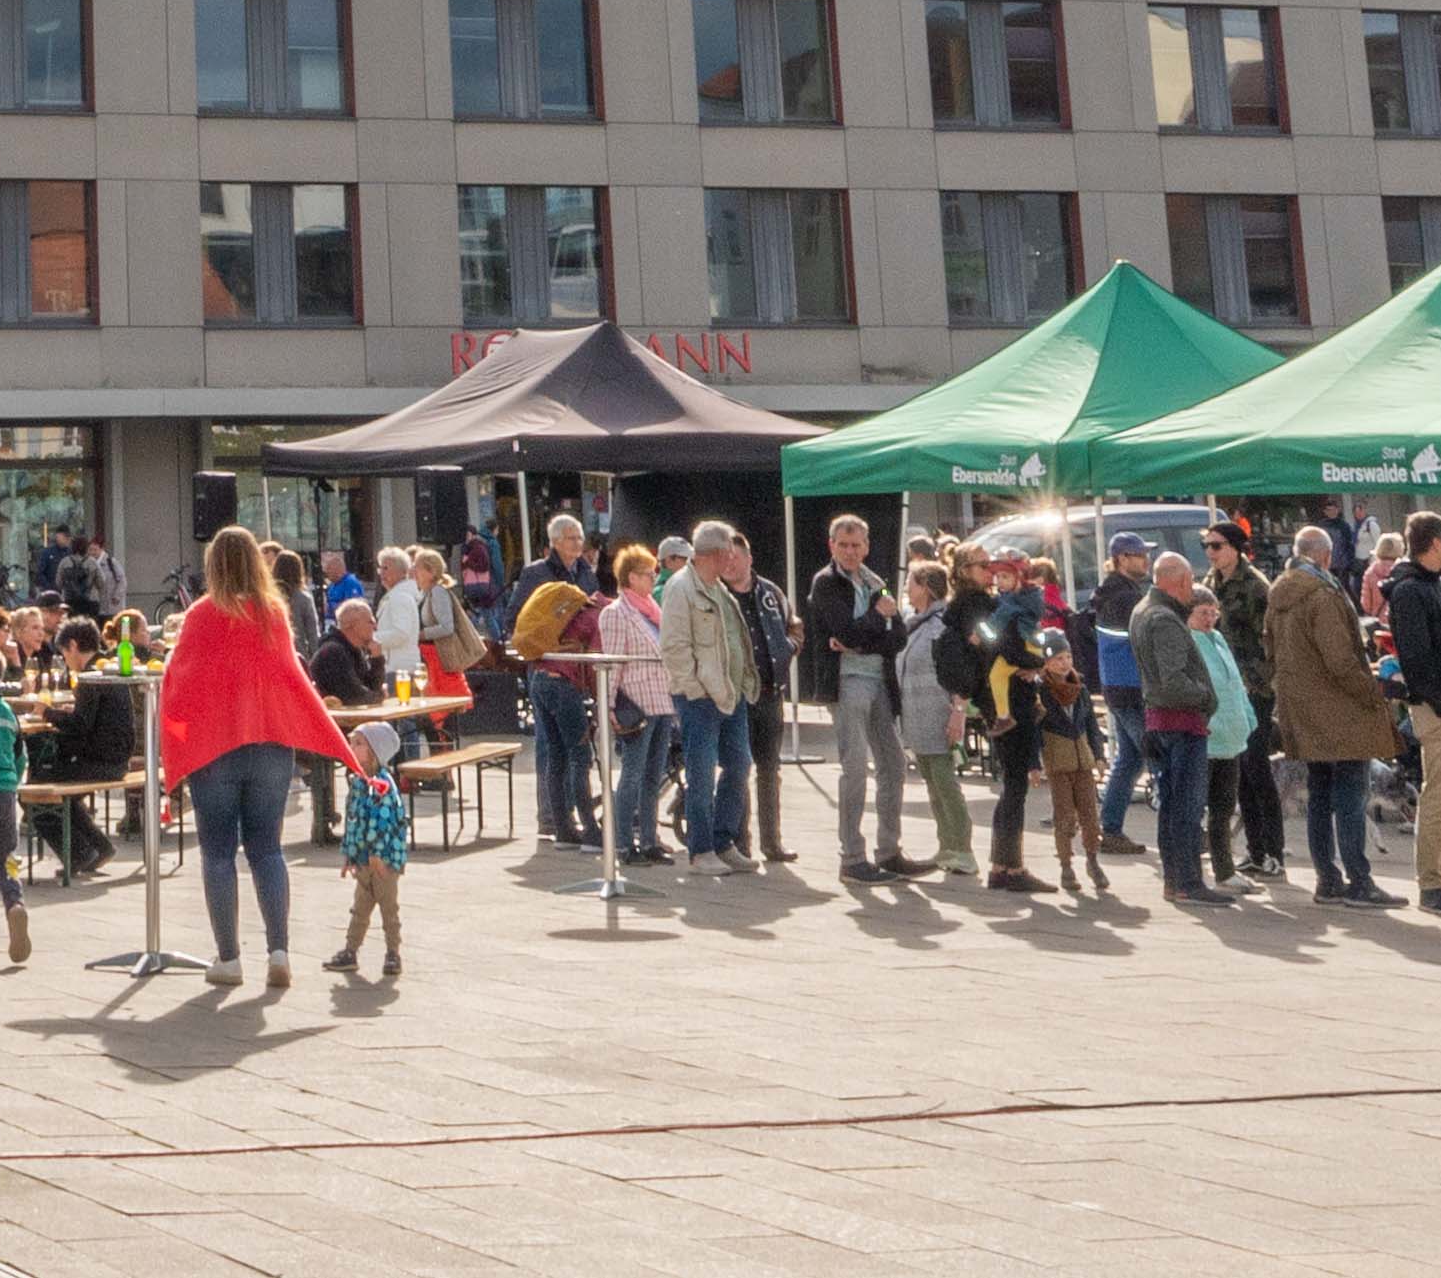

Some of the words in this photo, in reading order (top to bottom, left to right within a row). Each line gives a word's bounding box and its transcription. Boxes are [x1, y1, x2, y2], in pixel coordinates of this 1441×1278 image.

[1382, 447, 1406, 459] Stadt
[952, 465, 1016, 485] Eberswalde
[1322, 462, 1408, 483] Eberswalde
